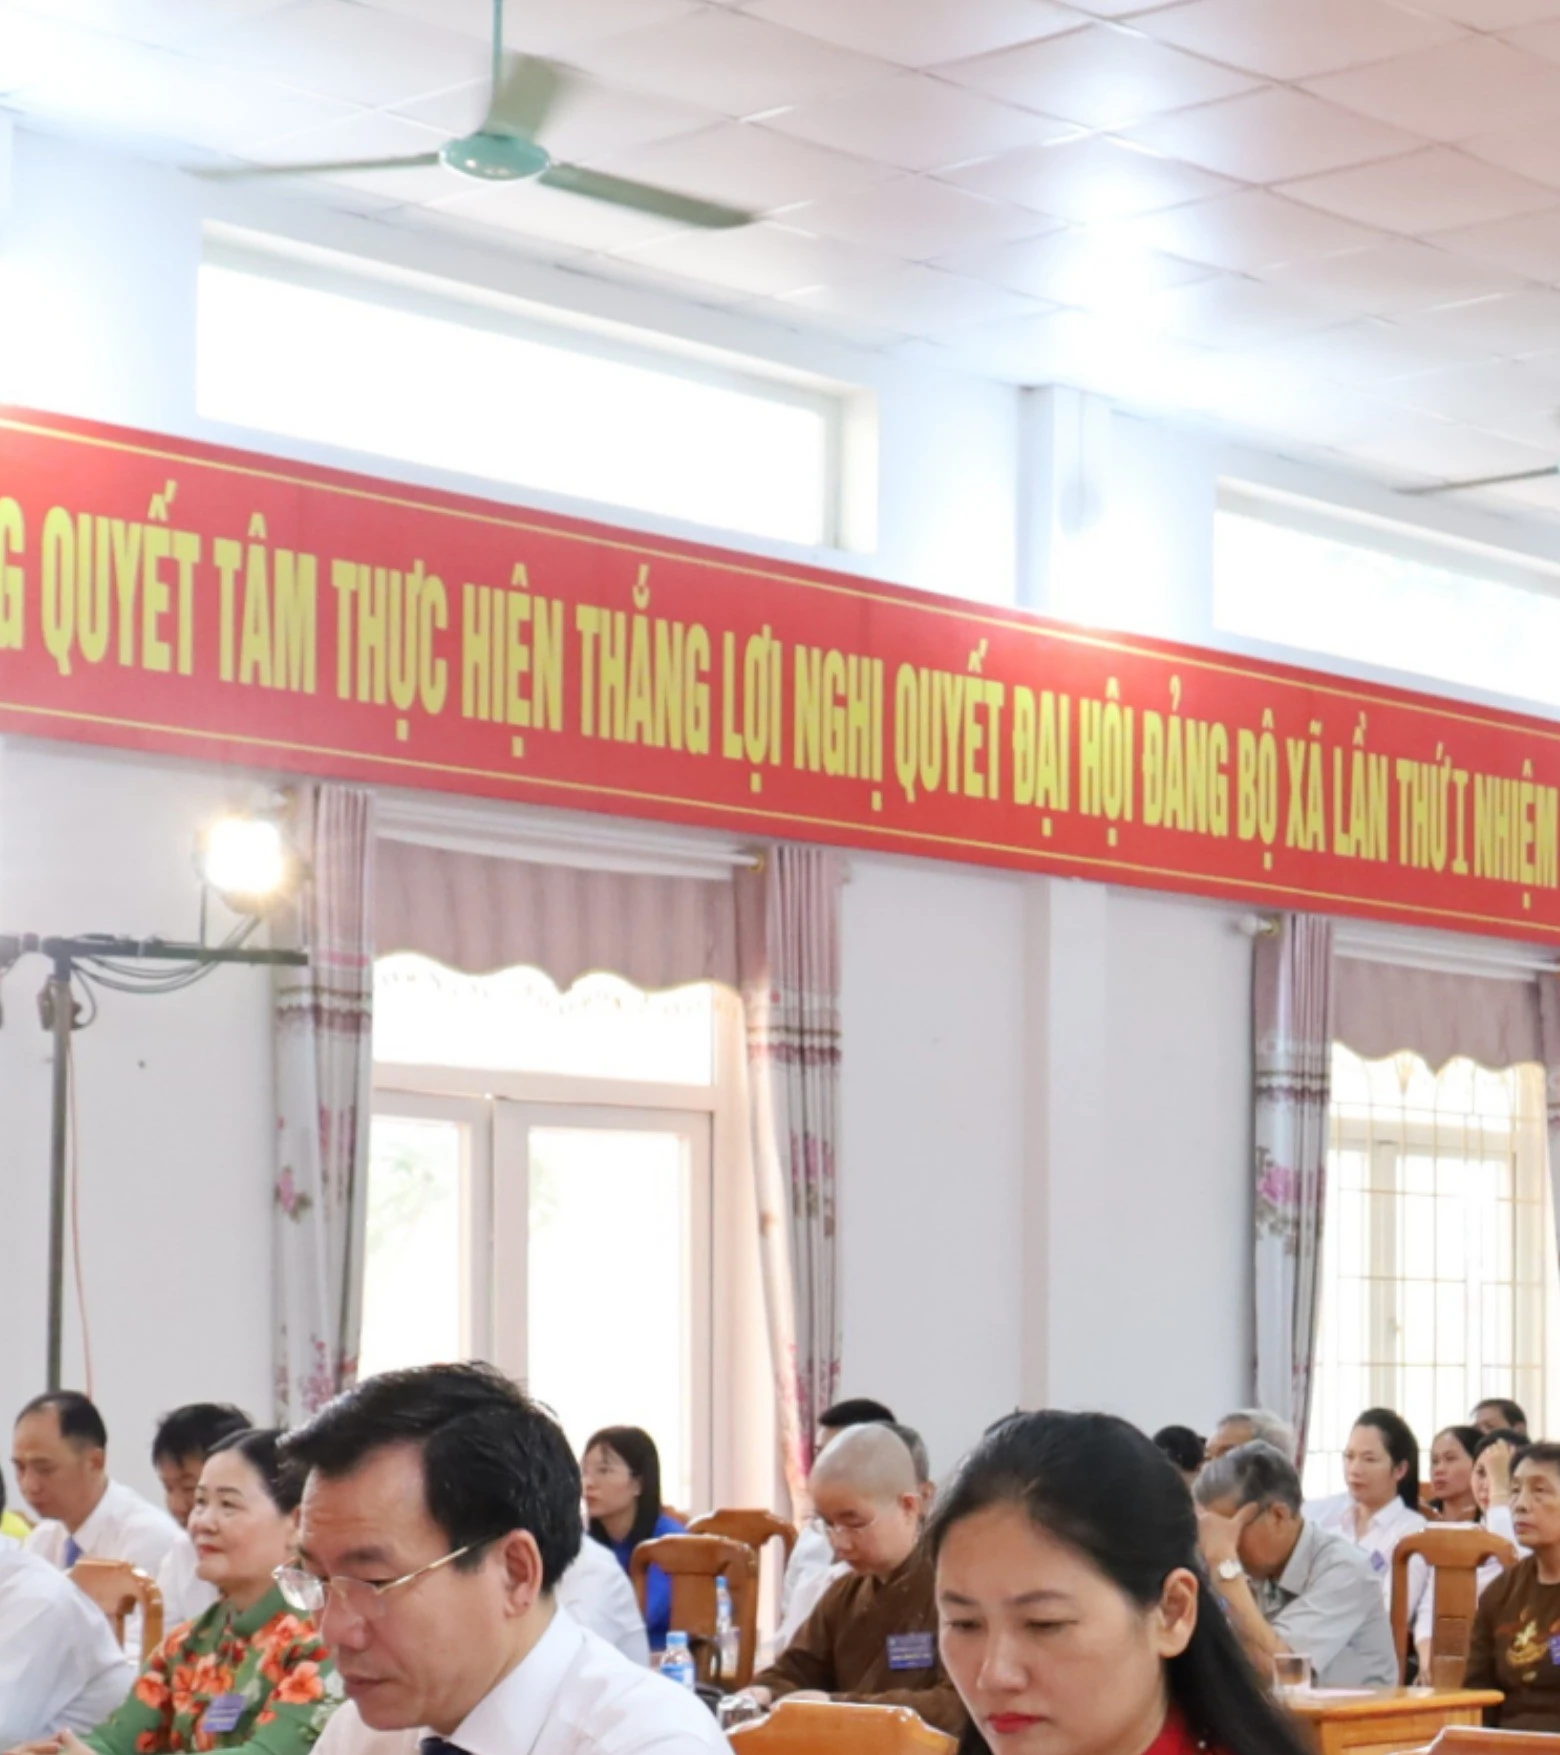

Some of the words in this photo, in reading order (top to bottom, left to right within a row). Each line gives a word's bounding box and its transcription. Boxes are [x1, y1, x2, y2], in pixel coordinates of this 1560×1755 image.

[40, 480, 201, 676] QUYẾT
[213, 513, 317, 693] TÂM
[331, 559, 448, 741] THỰC
[461, 563, 564, 757] HIỆN
[575, 565, 711, 756] THẮNG
[722, 624, 783, 793] LỢI
[793, 644, 885, 810] NGHỊ
[894, 639, 1006, 802] QUYẾT
[1011, 684, 1073, 837] ĐẠI
[1078, 677, 1136, 846] HỘI
[1141, 676, 1230, 838] ĐẢNG
[1236, 708, 1279, 869] BỘ
[1285, 719, 1326, 852] XÃ
[1333, 711, 1389, 862] LẦN
[1395, 742, 1452, 872] THỨ
[1473, 759, 1559, 909] NHIỆM
